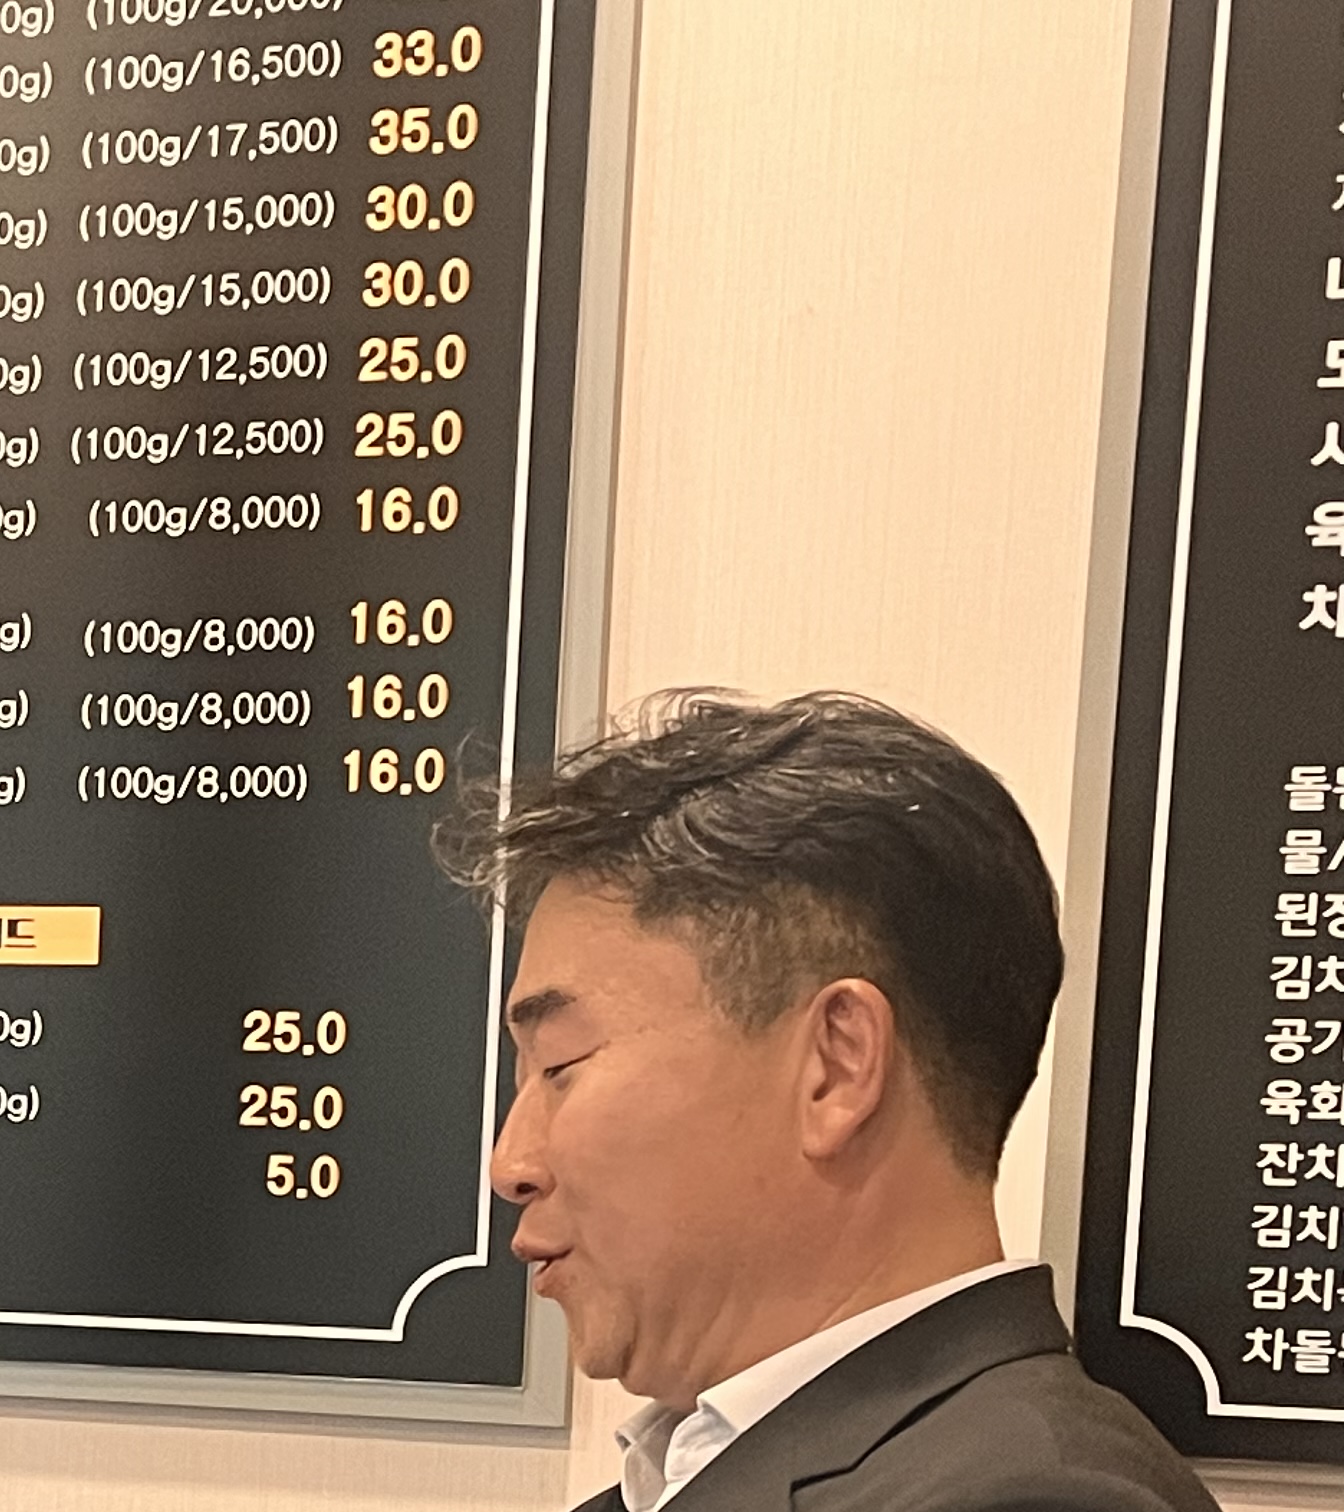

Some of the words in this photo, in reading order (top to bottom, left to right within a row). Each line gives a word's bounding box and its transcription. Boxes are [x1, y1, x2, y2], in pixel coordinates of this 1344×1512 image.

[84, 39, 342, 96] (100g/16,500)
[373, 26, 482, 78] 33.0
[81, 115, 338, 170] (100g/17,500)
[369, 104, 478, 155] 35.0
[79, 190, 335, 242] (100g/15,000)
[365, 180, 473, 231] 30.0
[76, 266, 331, 317] (100g/15,000)
[362, 257, 470, 307] 30.0
[74, 342, 328, 391] (100g/12,500)
[358, 334, 466, 383] 25.0
[71, 417, 324, 465] (100g/12,500)
[354, 409, 462, 459] 25.0
[89, 492, 320, 537] (100g/8,000)
[356, 486, 458, 534] 16.0
[84, 616, 315, 658] (100g/8,000)
[350, 599, 452, 646] 16.0
[81, 689, 311, 731] (100g/8,000)
[347, 673, 448, 721] 16.0
[78, 764, 307, 804] (100g/8,000)
[343, 748, 444, 796] 16.0
[242, 1010, 346, 1056] 25.0
[239, 1084, 343, 1131] 25.0
[266, 1154, 339, 1199] 5.0
[1251, 1203, 1344, 1250] 김치
[1246, 1265, 1344, 1312] 김치
[1241, 1325, 1344, 1375] 차돌
